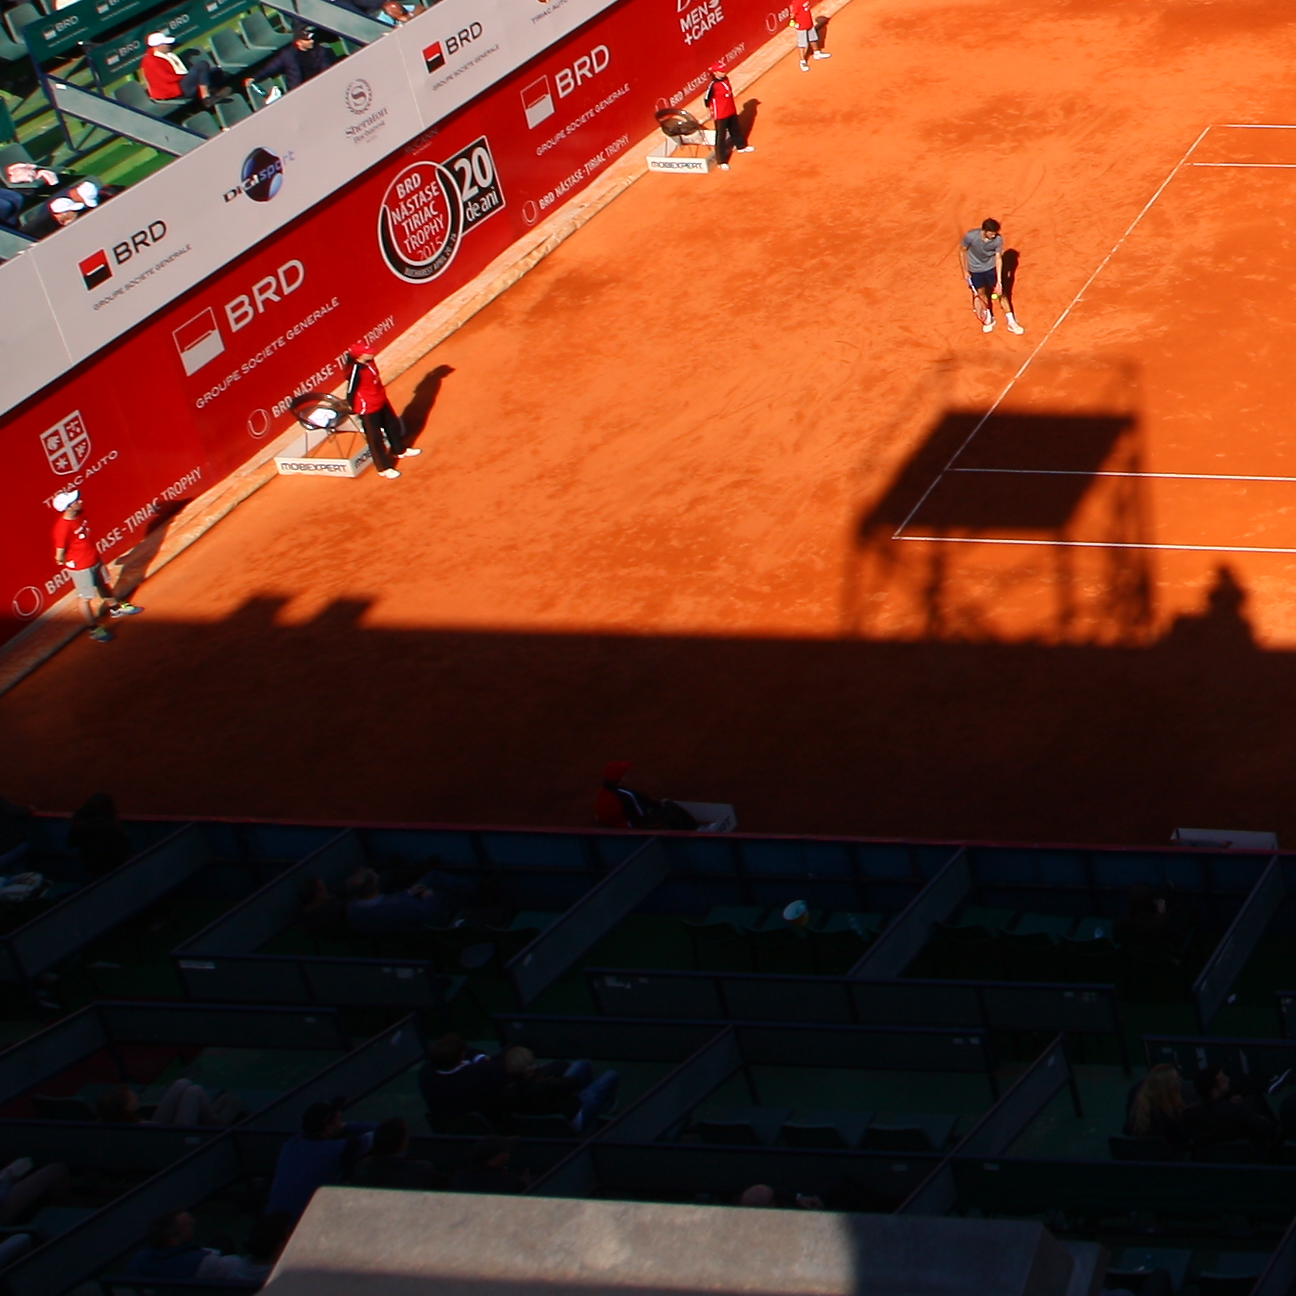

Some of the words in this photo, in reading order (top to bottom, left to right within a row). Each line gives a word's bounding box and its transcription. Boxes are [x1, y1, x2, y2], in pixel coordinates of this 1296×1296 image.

[679, 0, 711, 33] MEN
[444, 21, 484, 56] BRD
[554, 44, 610, 99] BRD
[535, 129, 567, 156] GROUPE
[595, 83, 631, 117] GENERALE
[396, 172, 422, 199] BRD
[454, 146, 494, 202] 20
[539, 191, 555, 210] BRD
[607, 133, 631, 161] TROPHY
[465, 200, 481, 222] de
[480, 186, 499, 212] ani
[112, 219, 168, 266] BRD
[404, 214, 444, 253] TROPHY
[224, 259, 306, 333] BRD
[363, 315, 396, 347] TROPHY
[195, 370, 242, 409] GROUPE
[241, 335, 286, 375] SOCIETE
[286, 296, 340, 340] GENERALE
[86, 450, 119, 478] AUTO
[162, 466, 204, 503] TROPHY
